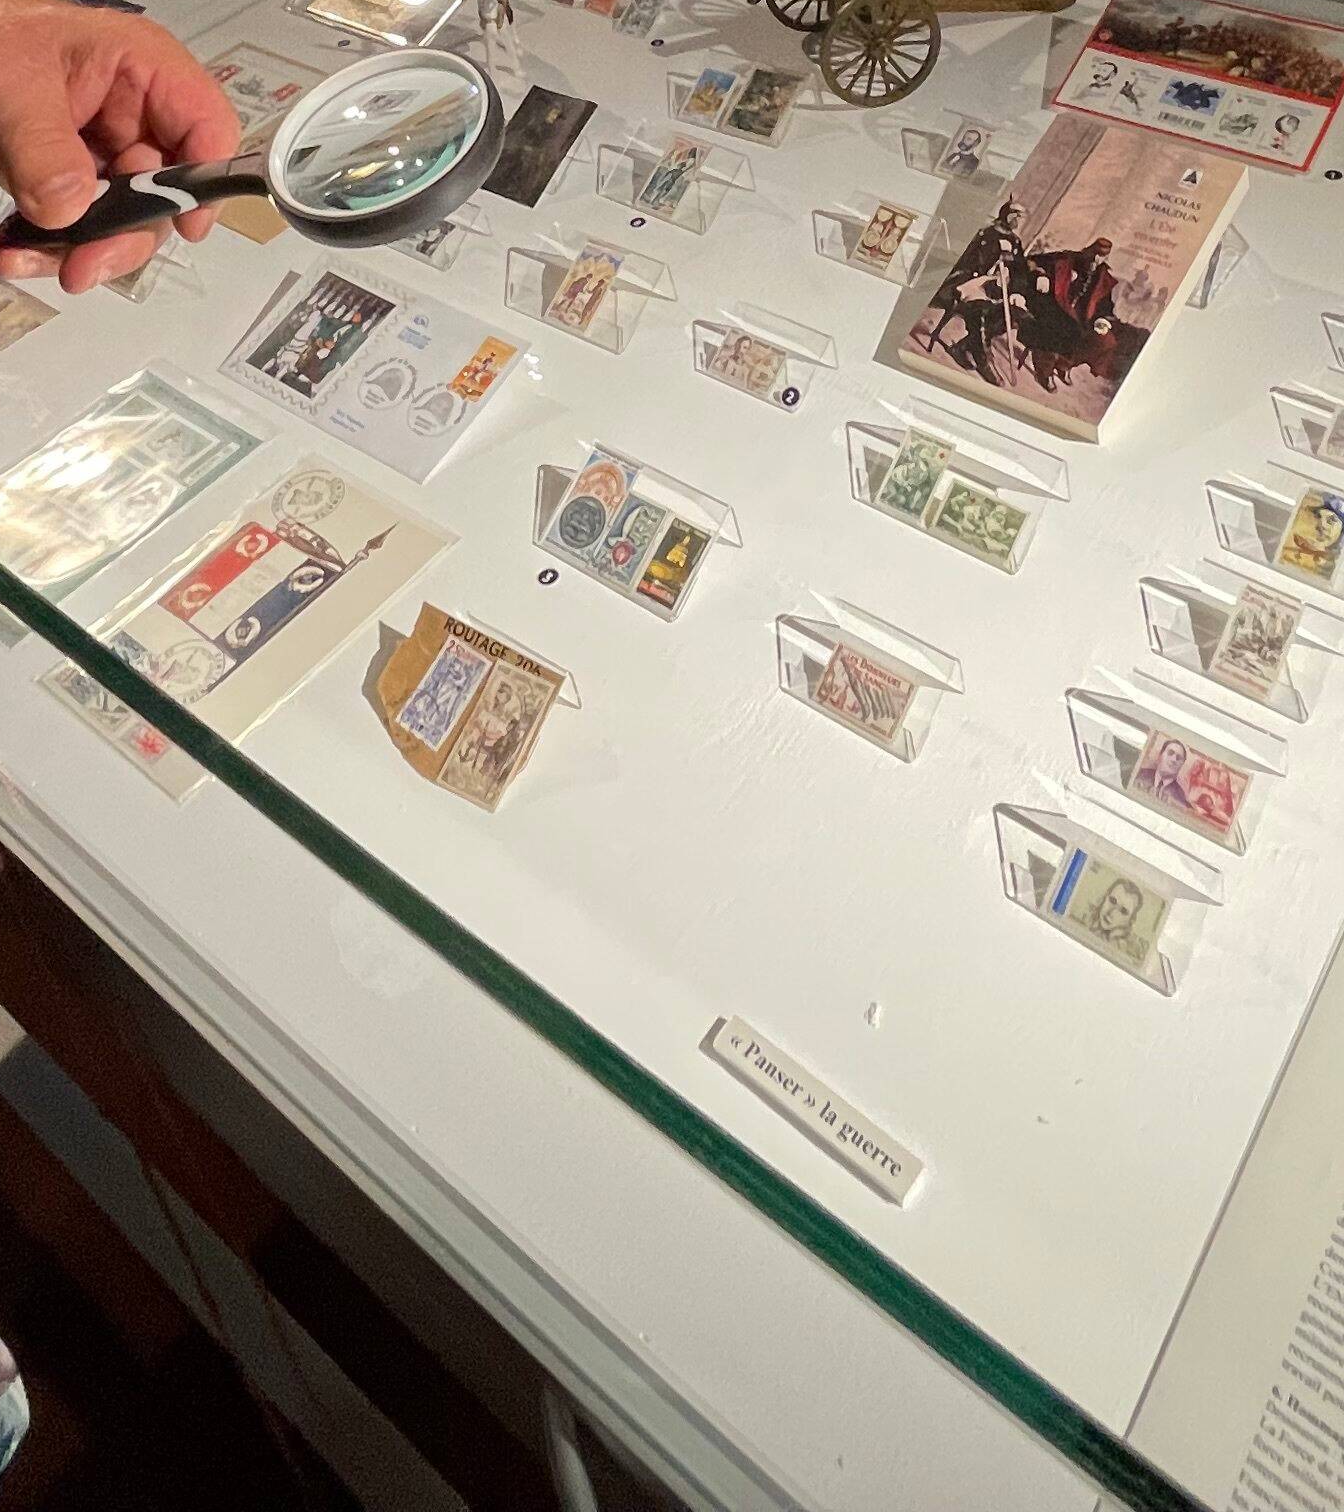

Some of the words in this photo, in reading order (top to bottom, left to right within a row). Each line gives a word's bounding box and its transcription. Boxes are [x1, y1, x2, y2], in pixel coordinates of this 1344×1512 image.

[443, 616, 511, 661] ROUTAGE
[743, 1039, 806, 1098] Panser
[818, 1099, 839, 1128] la
[835, 1120, 904, 1179] guerre
